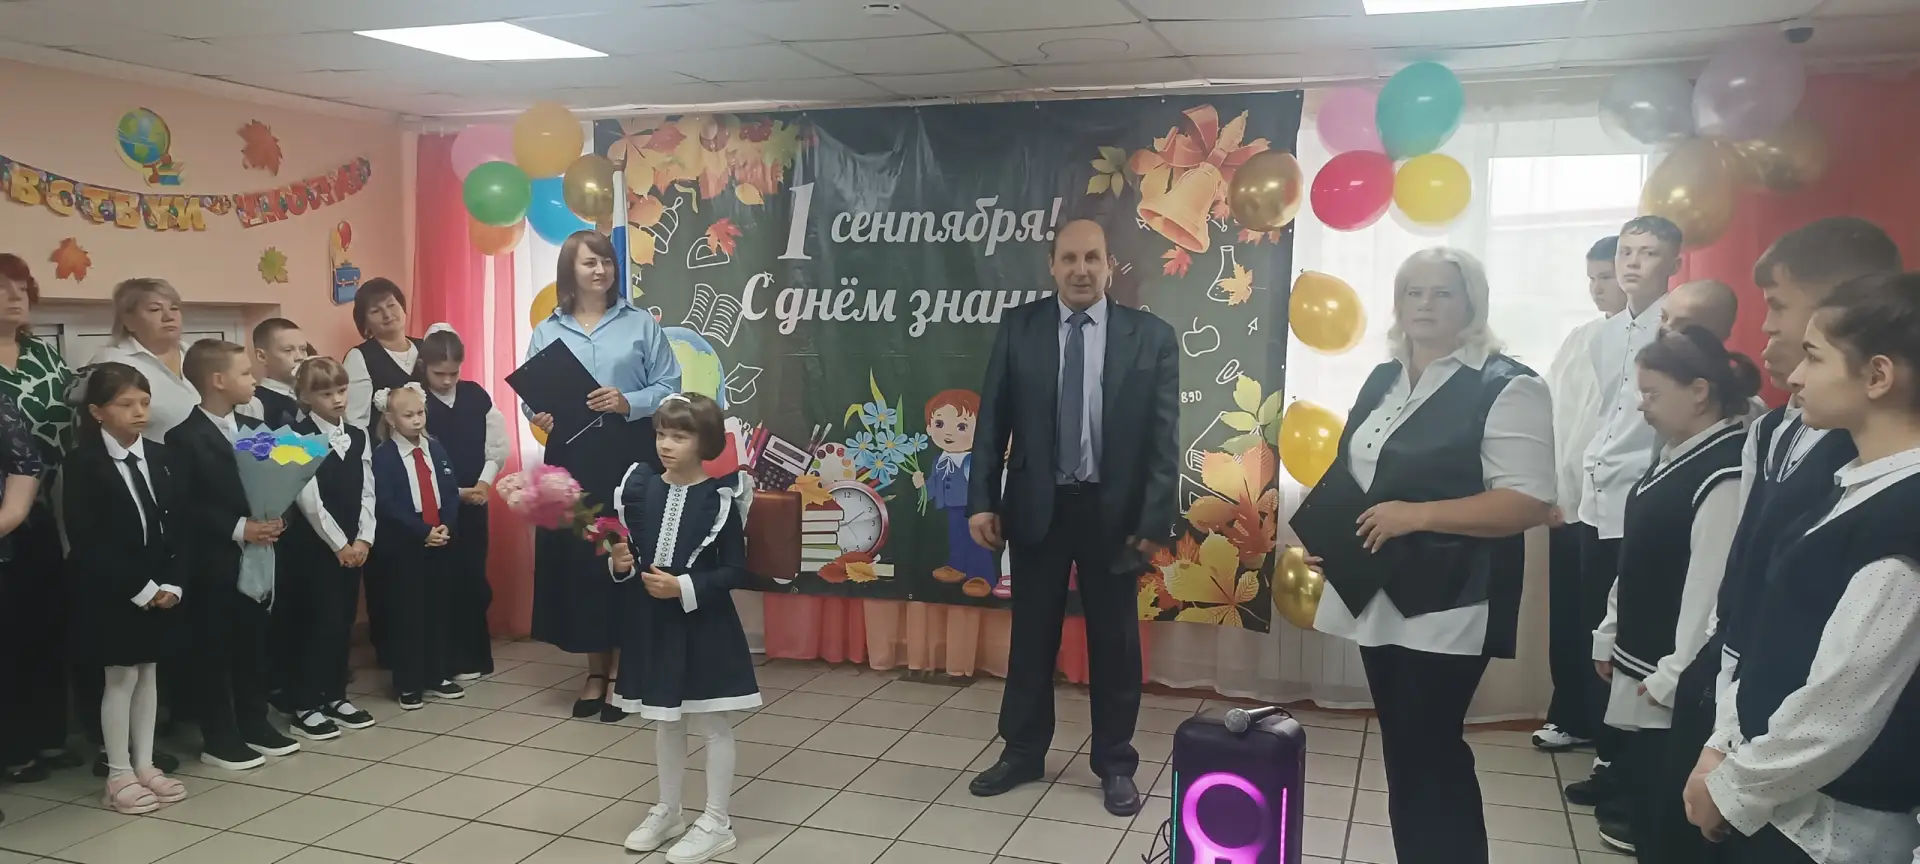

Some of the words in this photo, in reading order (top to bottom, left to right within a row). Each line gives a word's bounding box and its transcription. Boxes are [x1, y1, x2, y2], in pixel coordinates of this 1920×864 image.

[777, 182, 815, 260] 1
[831, 194, 1063, 257] сентября!
[741, 273, 770, 321] С
[774, 277, 897, 335] днём
